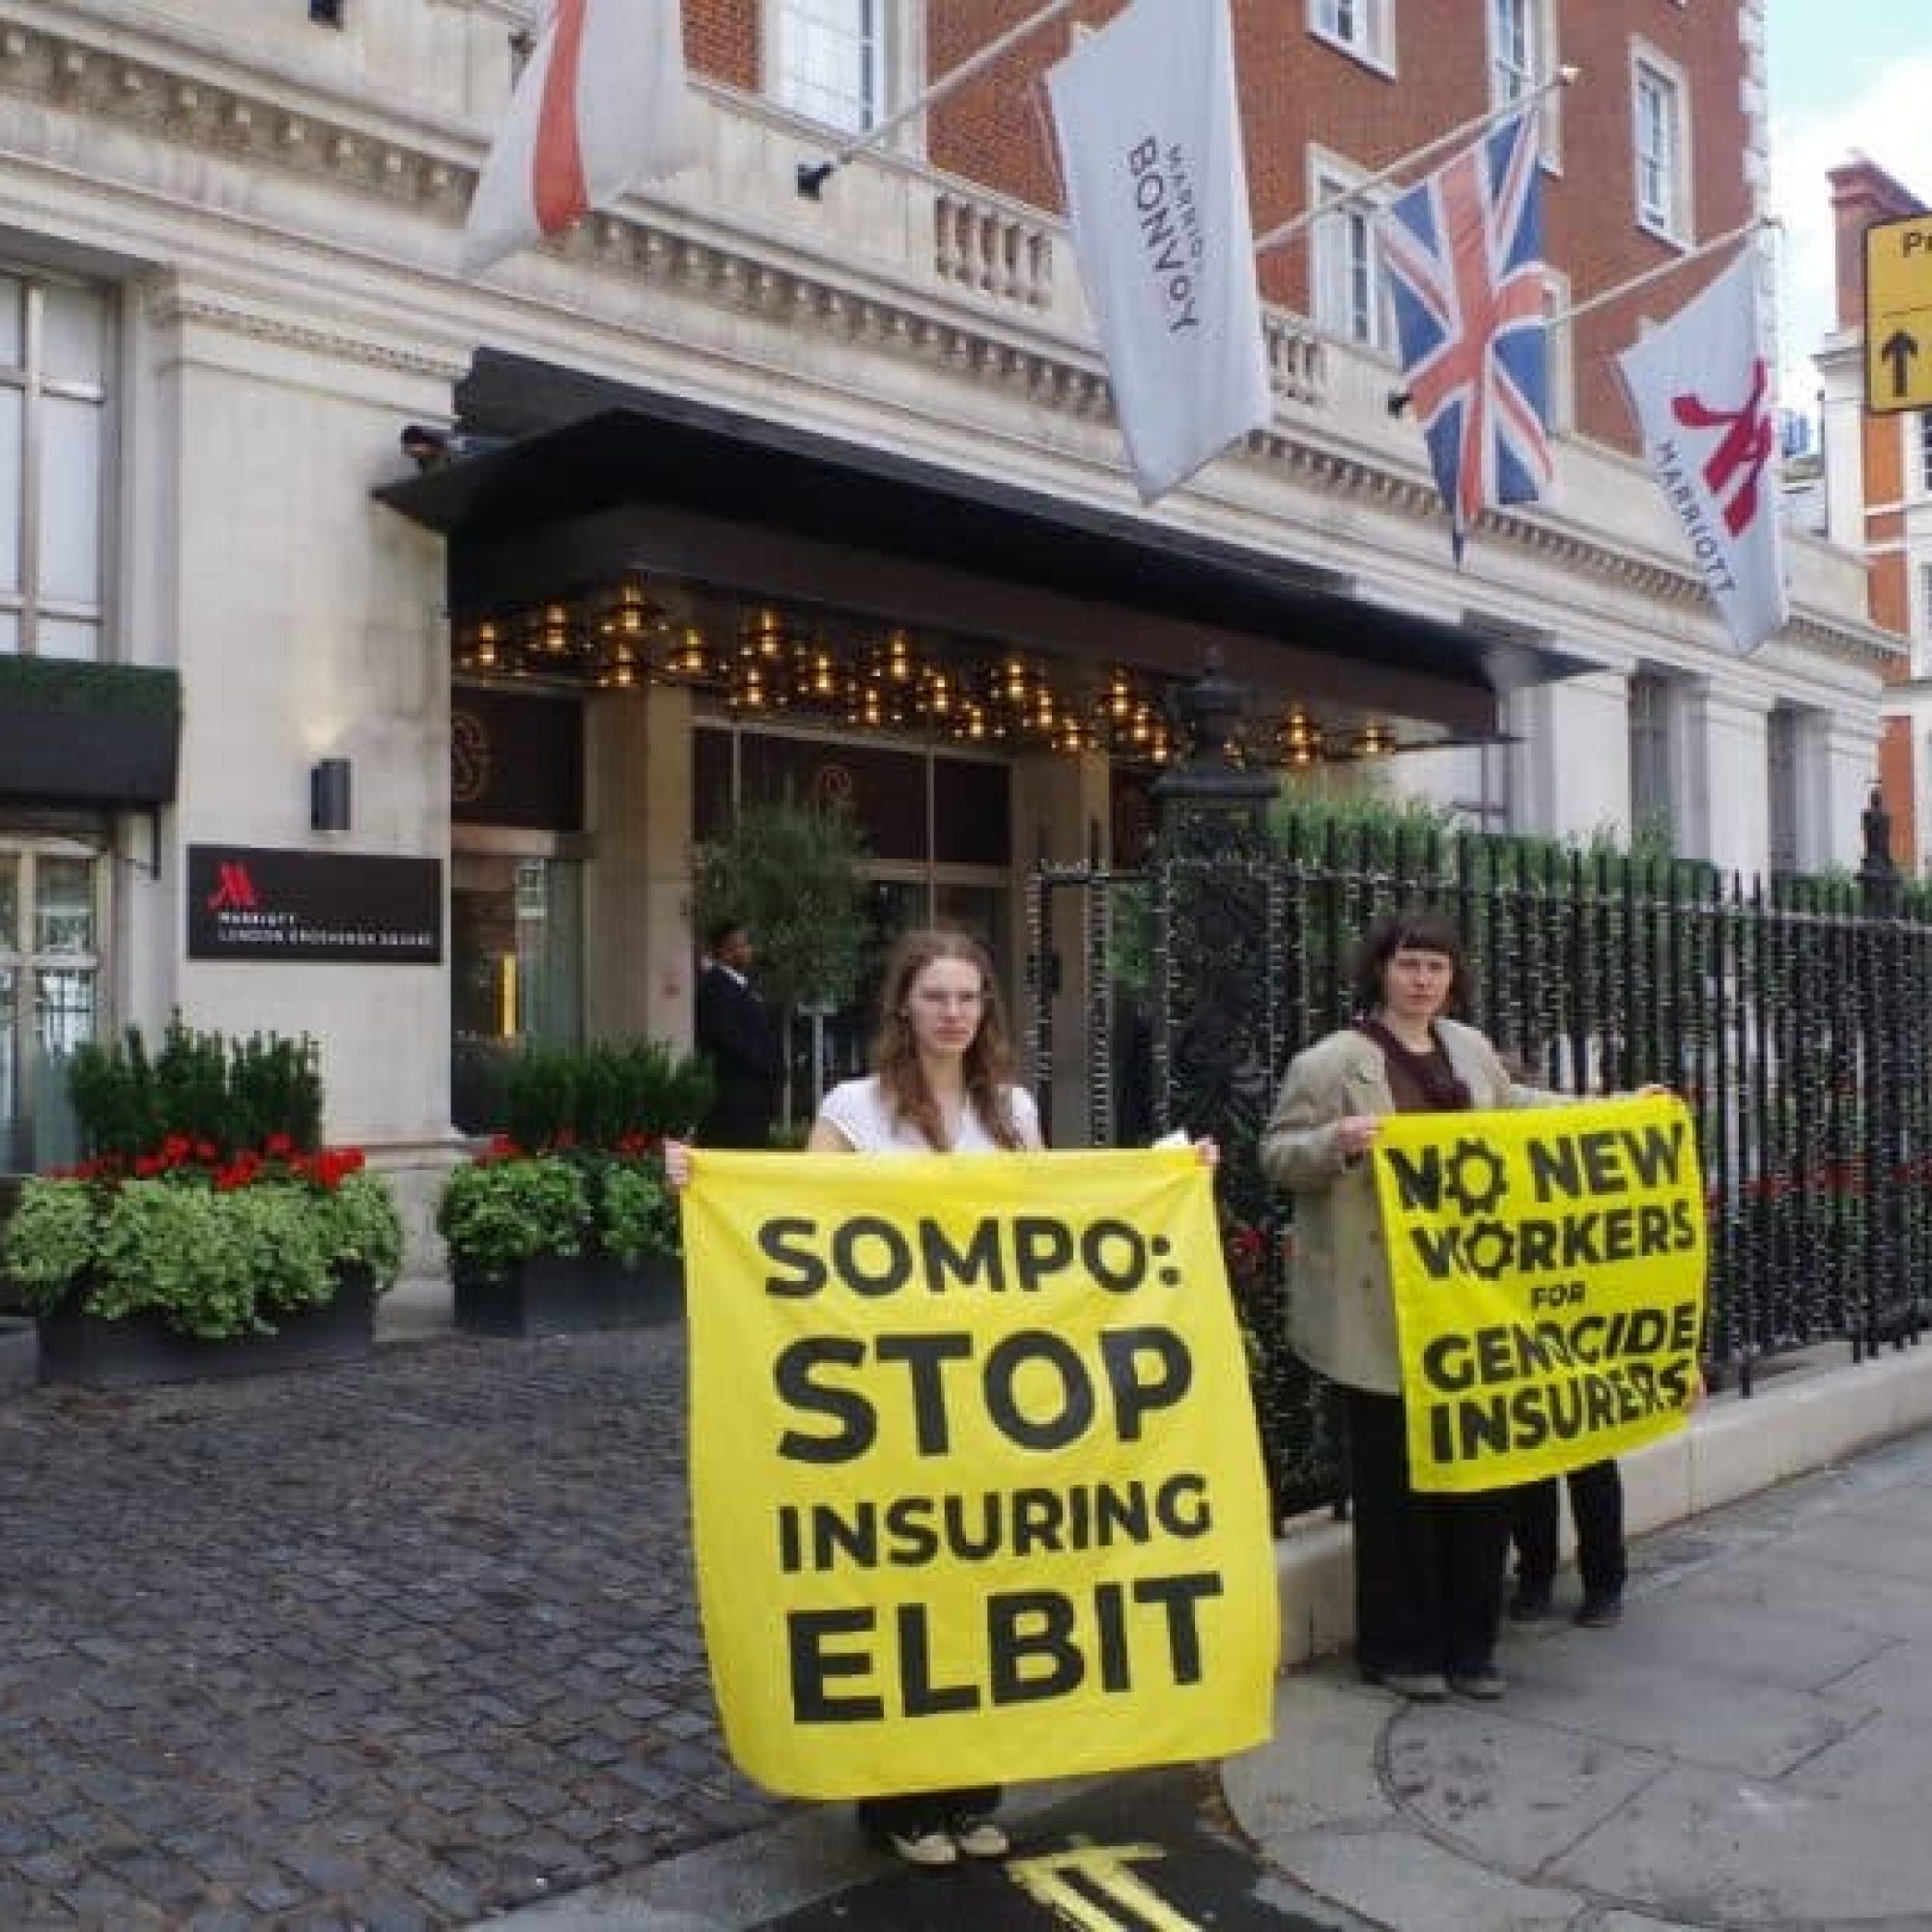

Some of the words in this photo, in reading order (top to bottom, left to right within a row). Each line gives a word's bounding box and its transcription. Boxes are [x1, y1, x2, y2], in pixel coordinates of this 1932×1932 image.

[1127, 135, 1200, 333] BONVOY
[1654, 439, 1737, 591] MARRIOTT
[1383, 1137, 1509, 1216] NO
[1525, 1122, 1685, 1204] NEW
[757, 1215, 1183, 1299] SOMPO:
[1407, 1198, 1697, 1280] WORKERS
[1530, 1280, 1587, 1310] FOR
[774, 1325, 1194, 1464] STOP
[1429, 1357, 1693, 1464] INSURERS
[777, 1472, 1213, 1574] INSURING
[785, 1570, 1224, 1726] ELBIT
